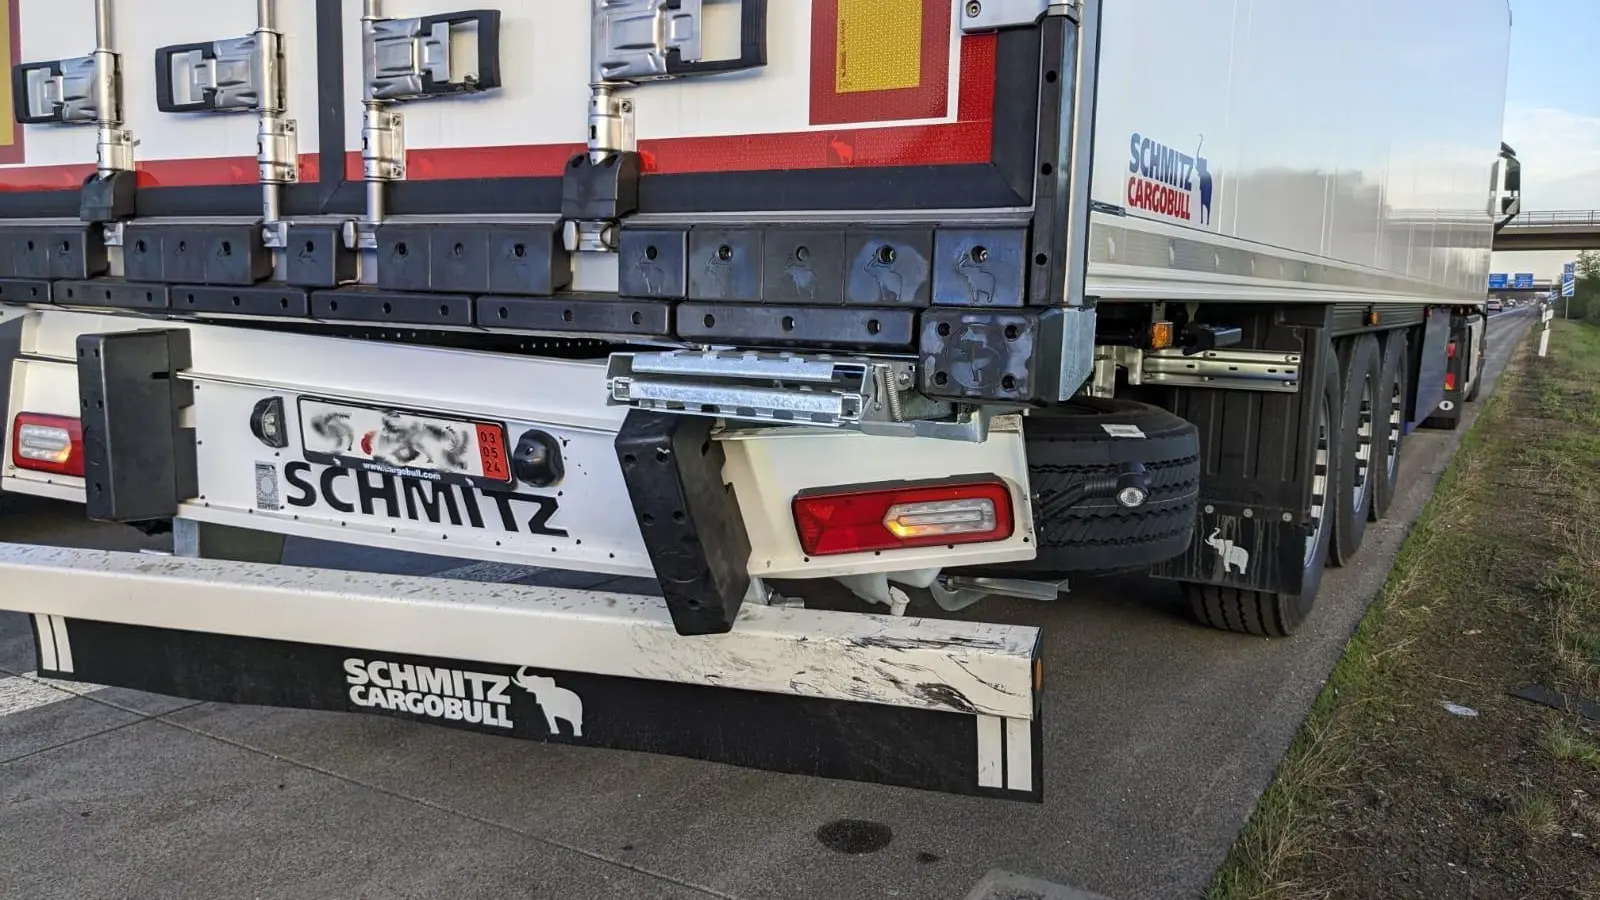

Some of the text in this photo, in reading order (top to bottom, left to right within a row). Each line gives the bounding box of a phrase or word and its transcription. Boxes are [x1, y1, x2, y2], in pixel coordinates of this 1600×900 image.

[1129, 133, 1194, 191] SCHMITZ
[1128, 177, 1190, 220] CARGOBULL
[480, 432, 495, 443] 03
[483, 446, 498, 458] 05
[363, 462, 441, 480] www.cargobull.com
[486, 461, 501, 473] 24
[284, 461, 569, 537] SCHMITZ
[343, 658, 511, 704] SCHMITZ
[349, 686, 513, 728] CARGOBULL
